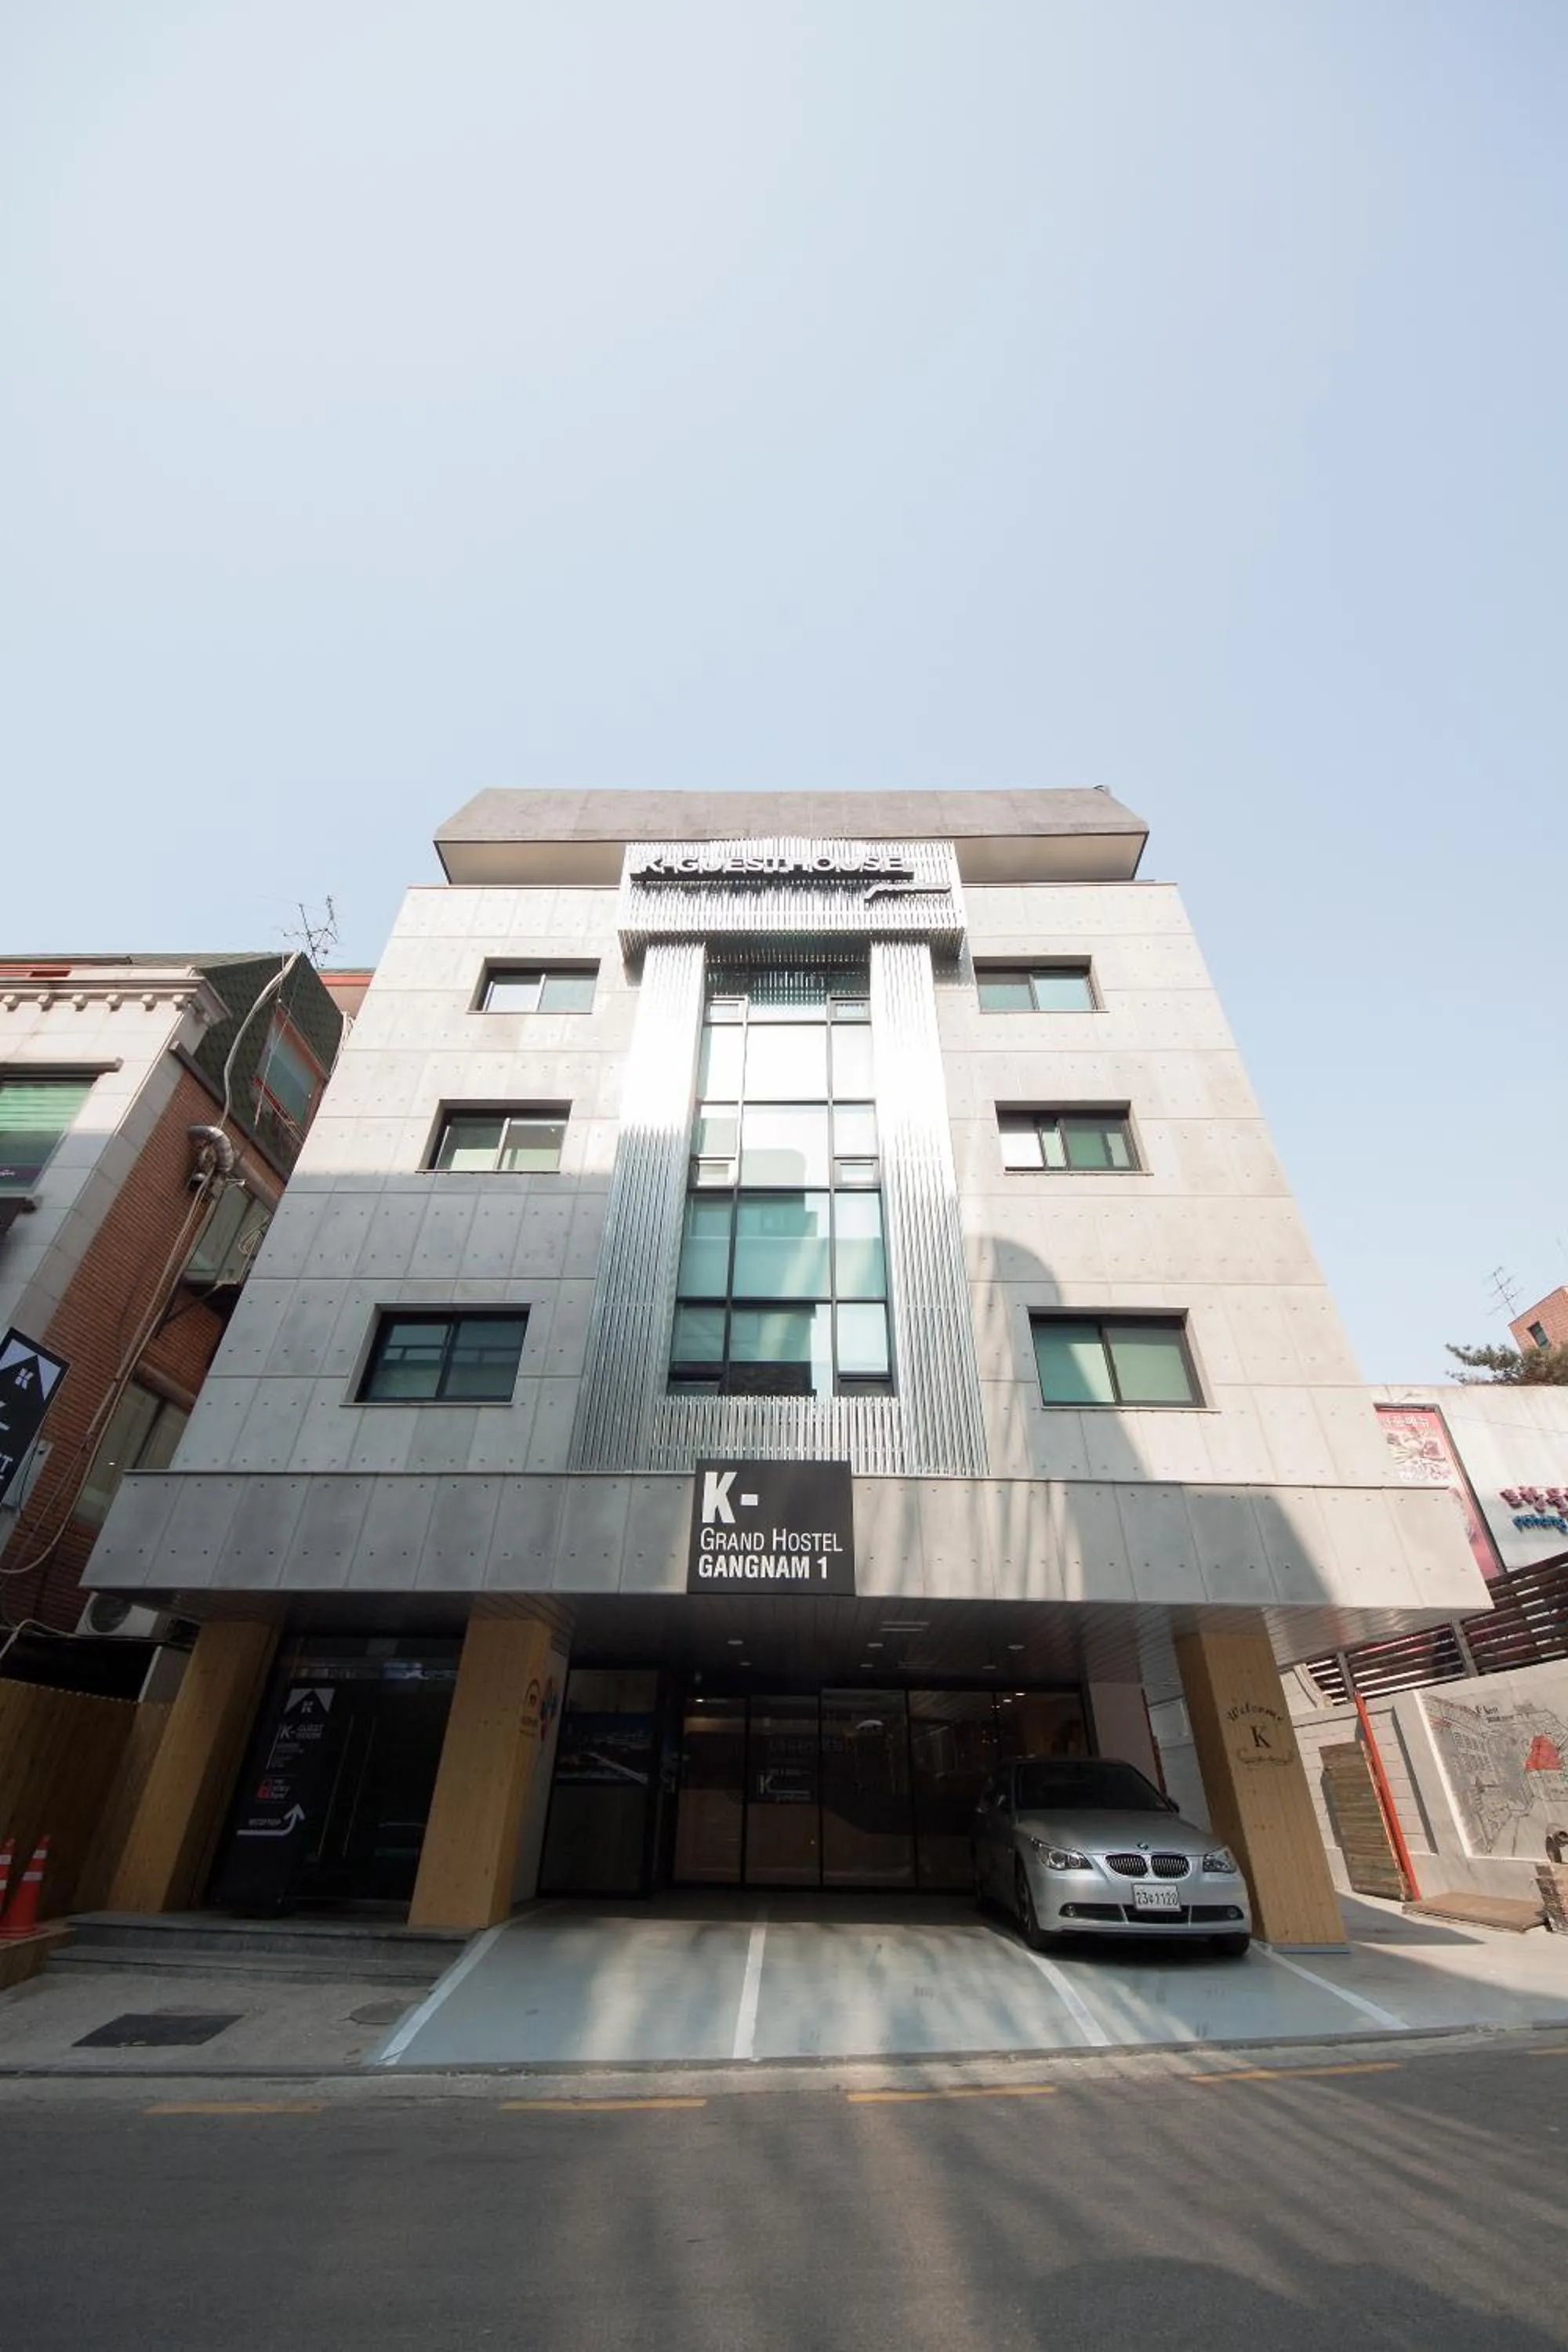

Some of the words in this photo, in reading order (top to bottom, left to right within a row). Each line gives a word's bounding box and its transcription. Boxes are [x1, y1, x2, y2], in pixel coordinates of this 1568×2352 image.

[700, 1527, 764, 1551] GRAND
[772, 1528, 843, 1552] HOSTEL
[699, 1555, 811, 1579] GANGNAM
[816, 1555, 828, 1580] 1
[1250, 1725, 1272, 1748] K
